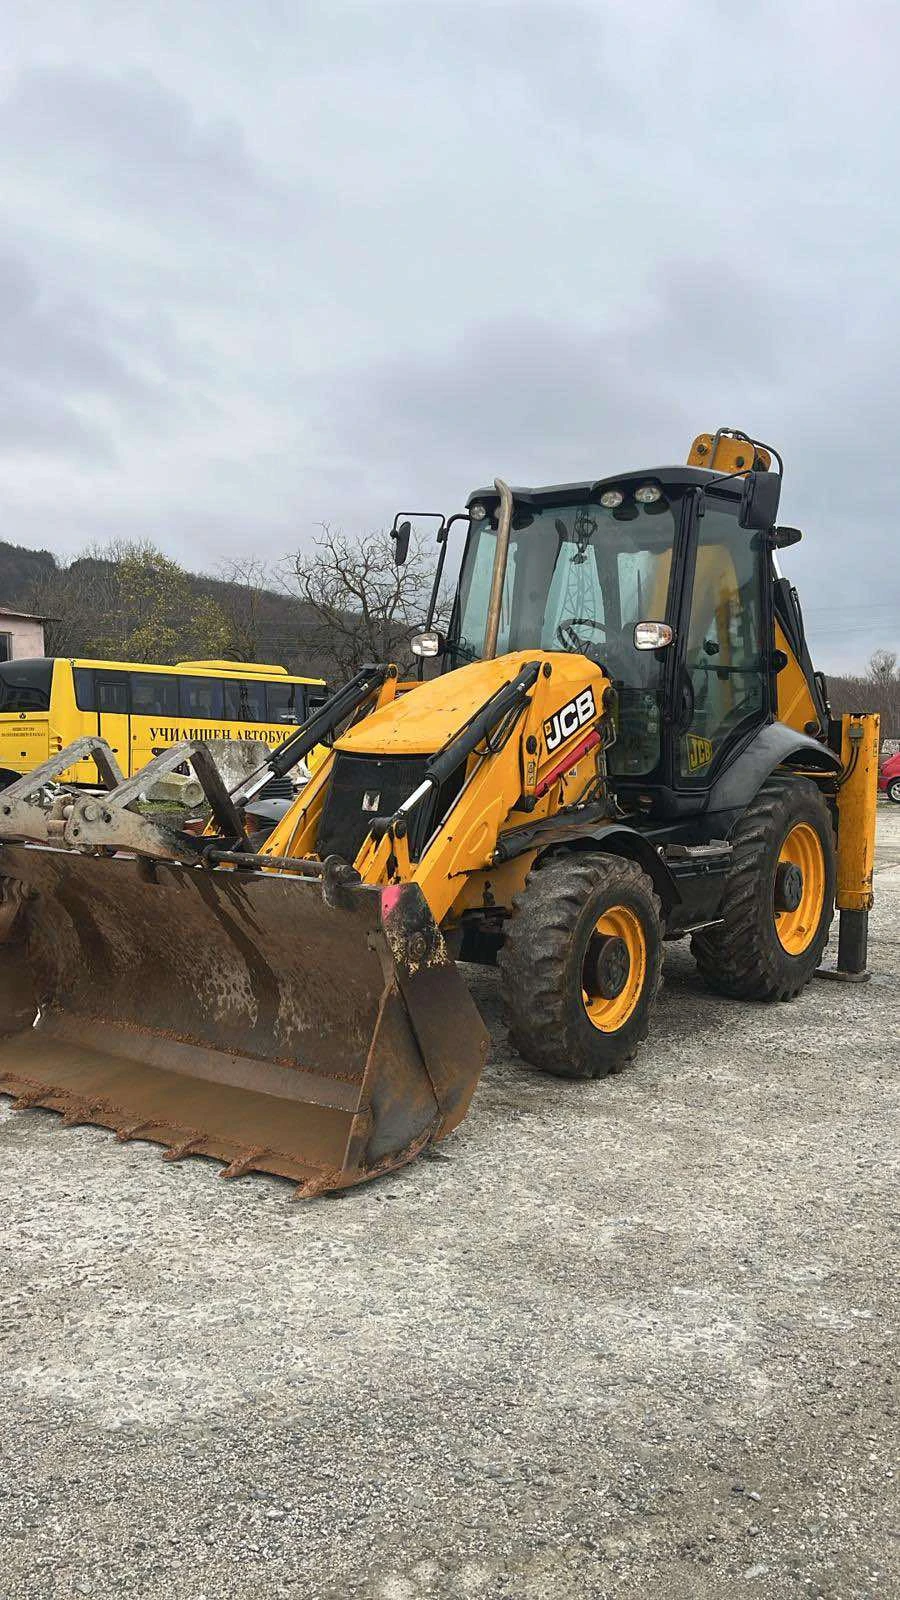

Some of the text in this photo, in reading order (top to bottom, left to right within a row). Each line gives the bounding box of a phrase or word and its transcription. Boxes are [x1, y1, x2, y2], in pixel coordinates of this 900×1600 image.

[546, 690, 595, 750] JCB
[236, 729, 290, 743] АВТОБУС
[690, 738, 711, 768] JCB
